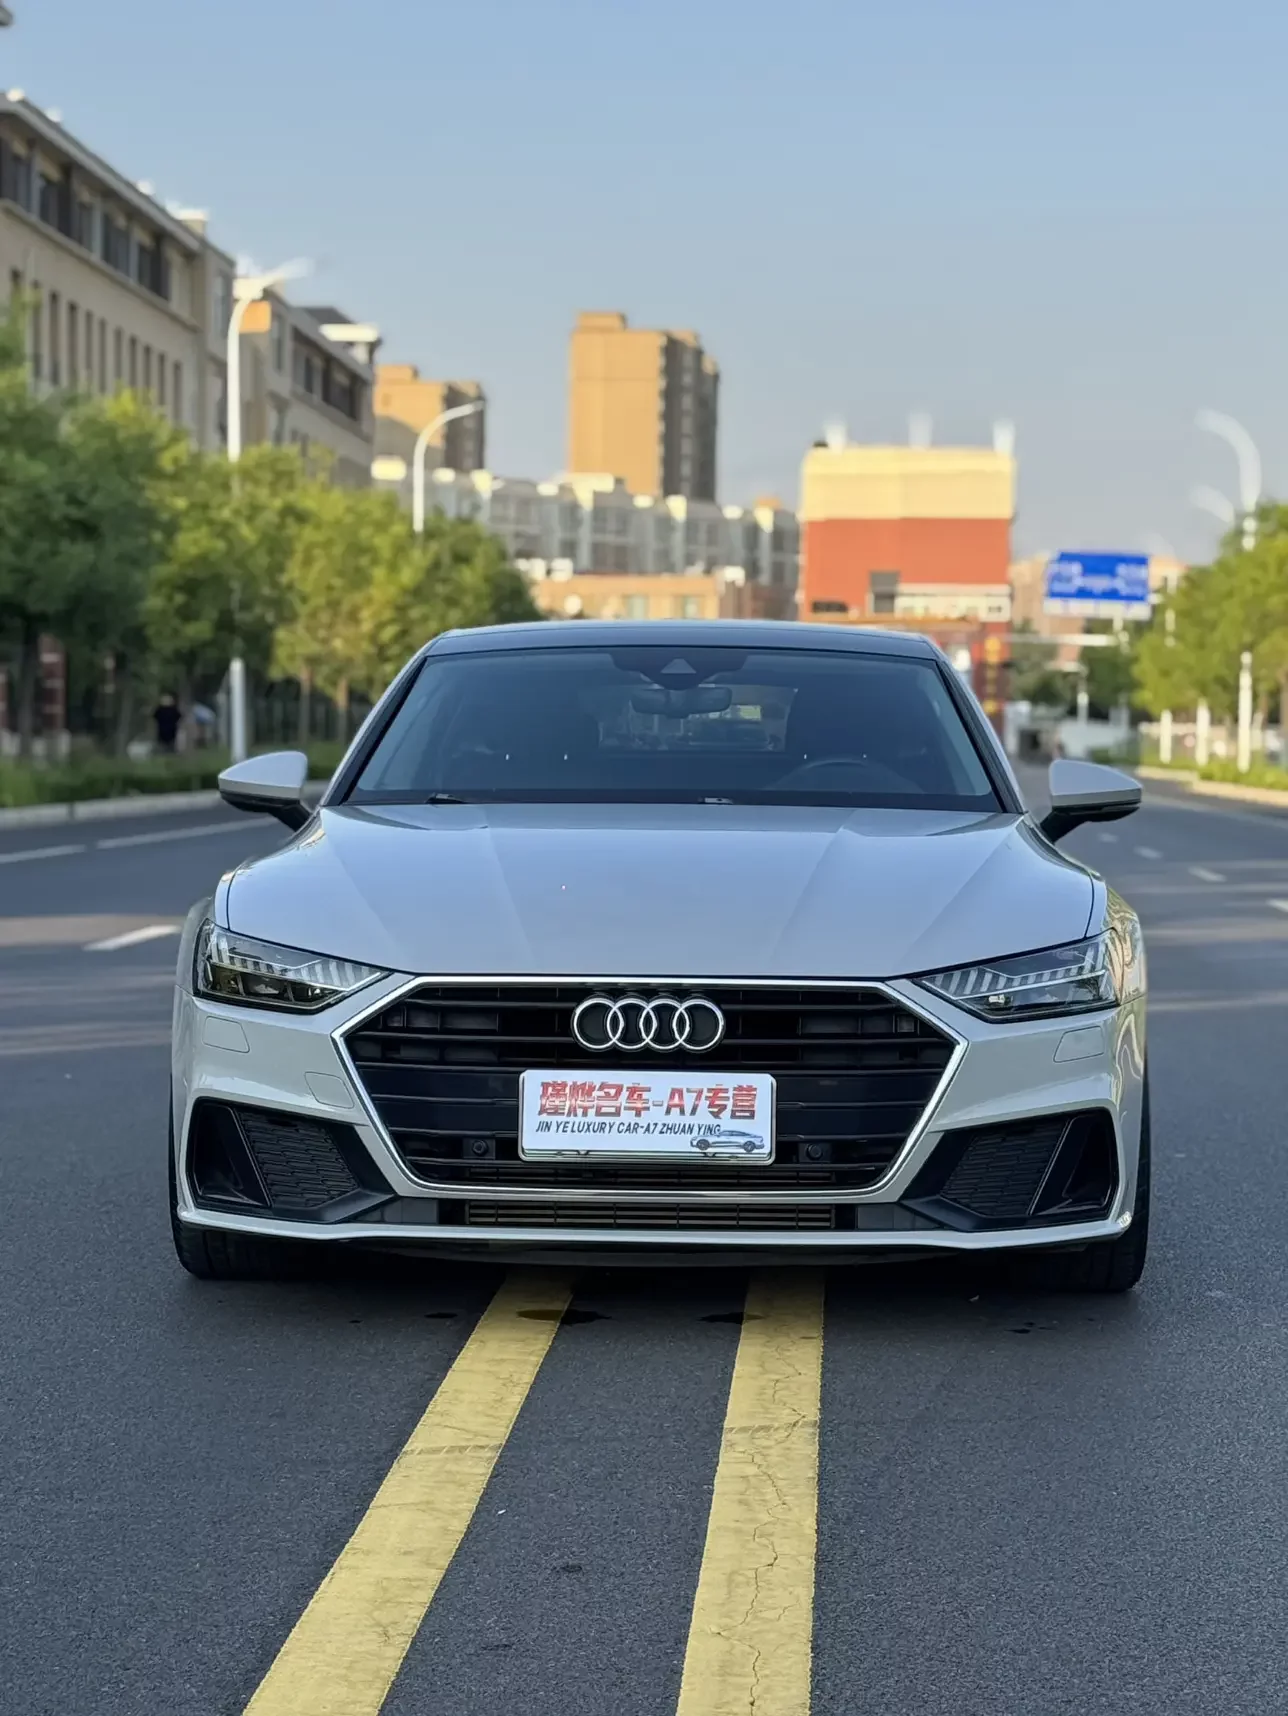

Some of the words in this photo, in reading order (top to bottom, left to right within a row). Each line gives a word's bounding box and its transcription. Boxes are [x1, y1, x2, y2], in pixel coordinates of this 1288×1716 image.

[536, 1121, 552, 1133] JIN
[555, 1121, 570, 1133] YE
[571, 1121, 615, 1134] LUXURY
[617, 1122, 658, 1135] CAR-A7
[659, 1123, 695, 1135] ZHUAN
[697, 1124, 721, 1136] YING
